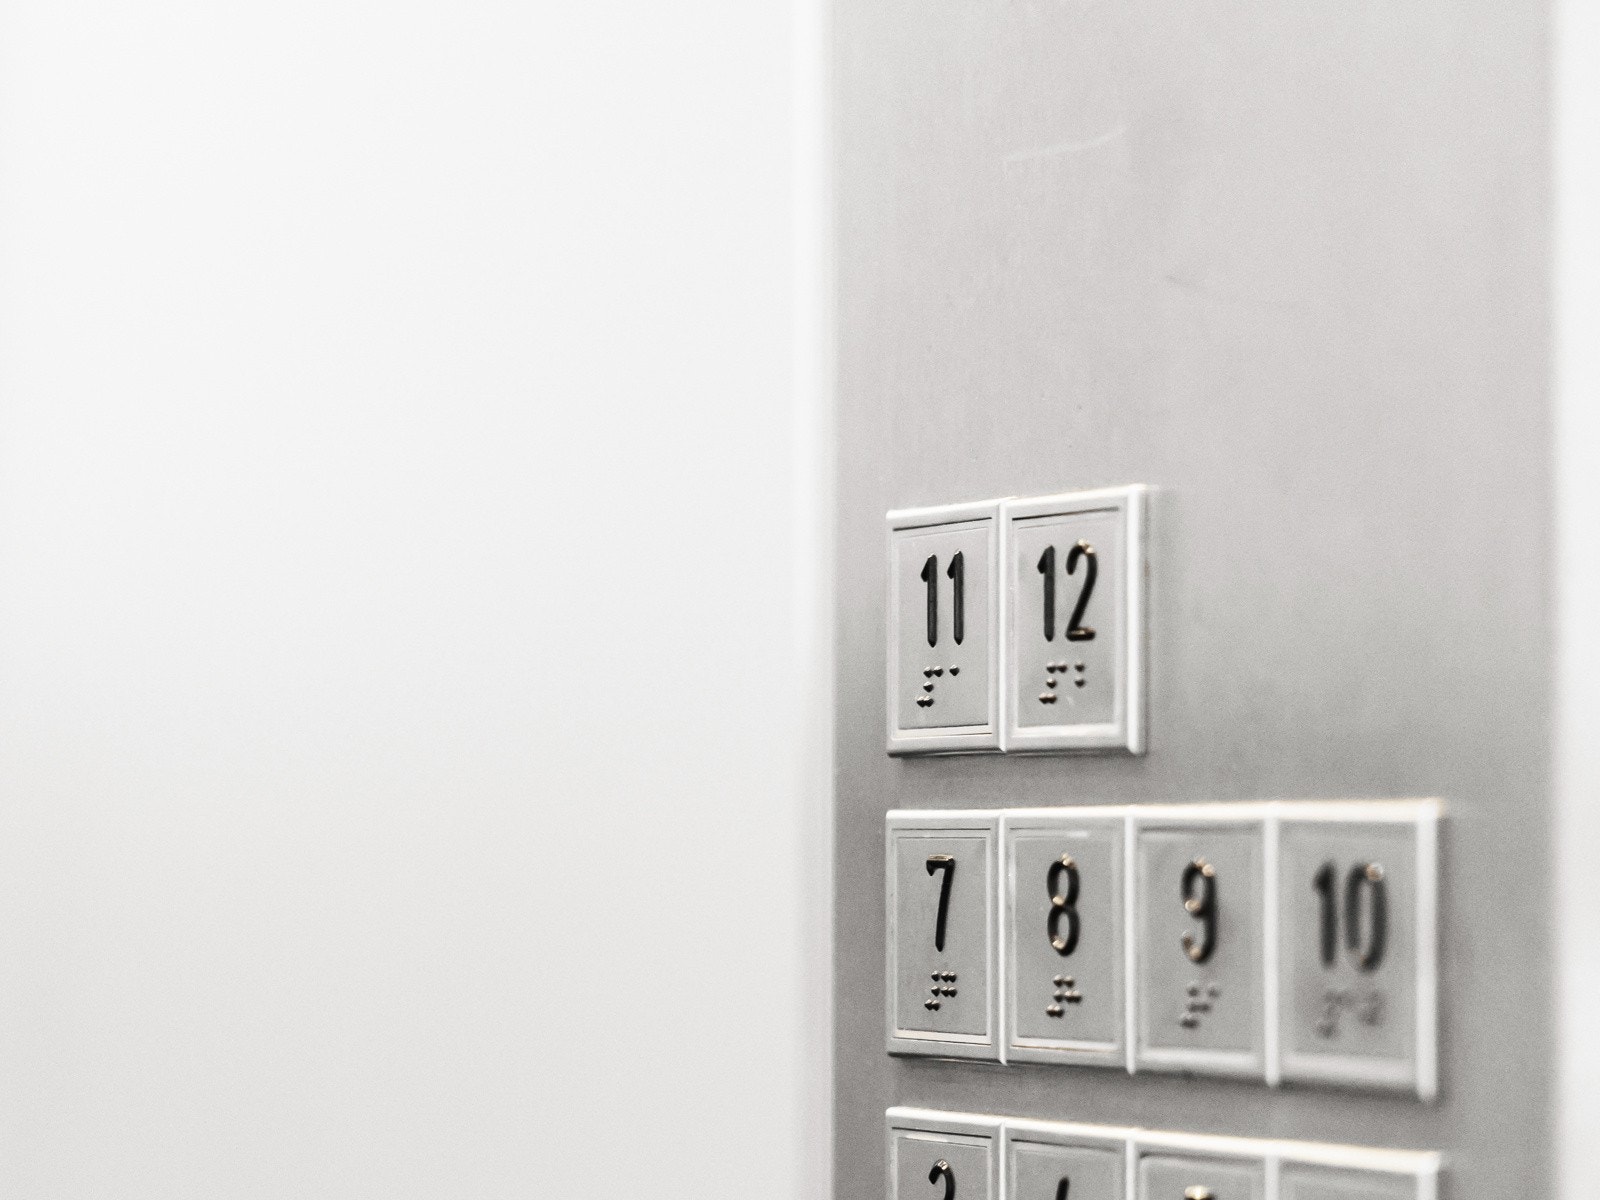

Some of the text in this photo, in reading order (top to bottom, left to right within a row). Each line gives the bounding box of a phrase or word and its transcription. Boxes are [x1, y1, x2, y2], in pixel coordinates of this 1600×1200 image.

[920, 549, 965, 648] 11
[1036, 538, 1098, 642] 12
[926, 854, 955, 952] 7
[1046, 854, 1080, 956] 8
[1180, 857, 1219, 964] 9
[1312, 859, 1388, 973] 10
